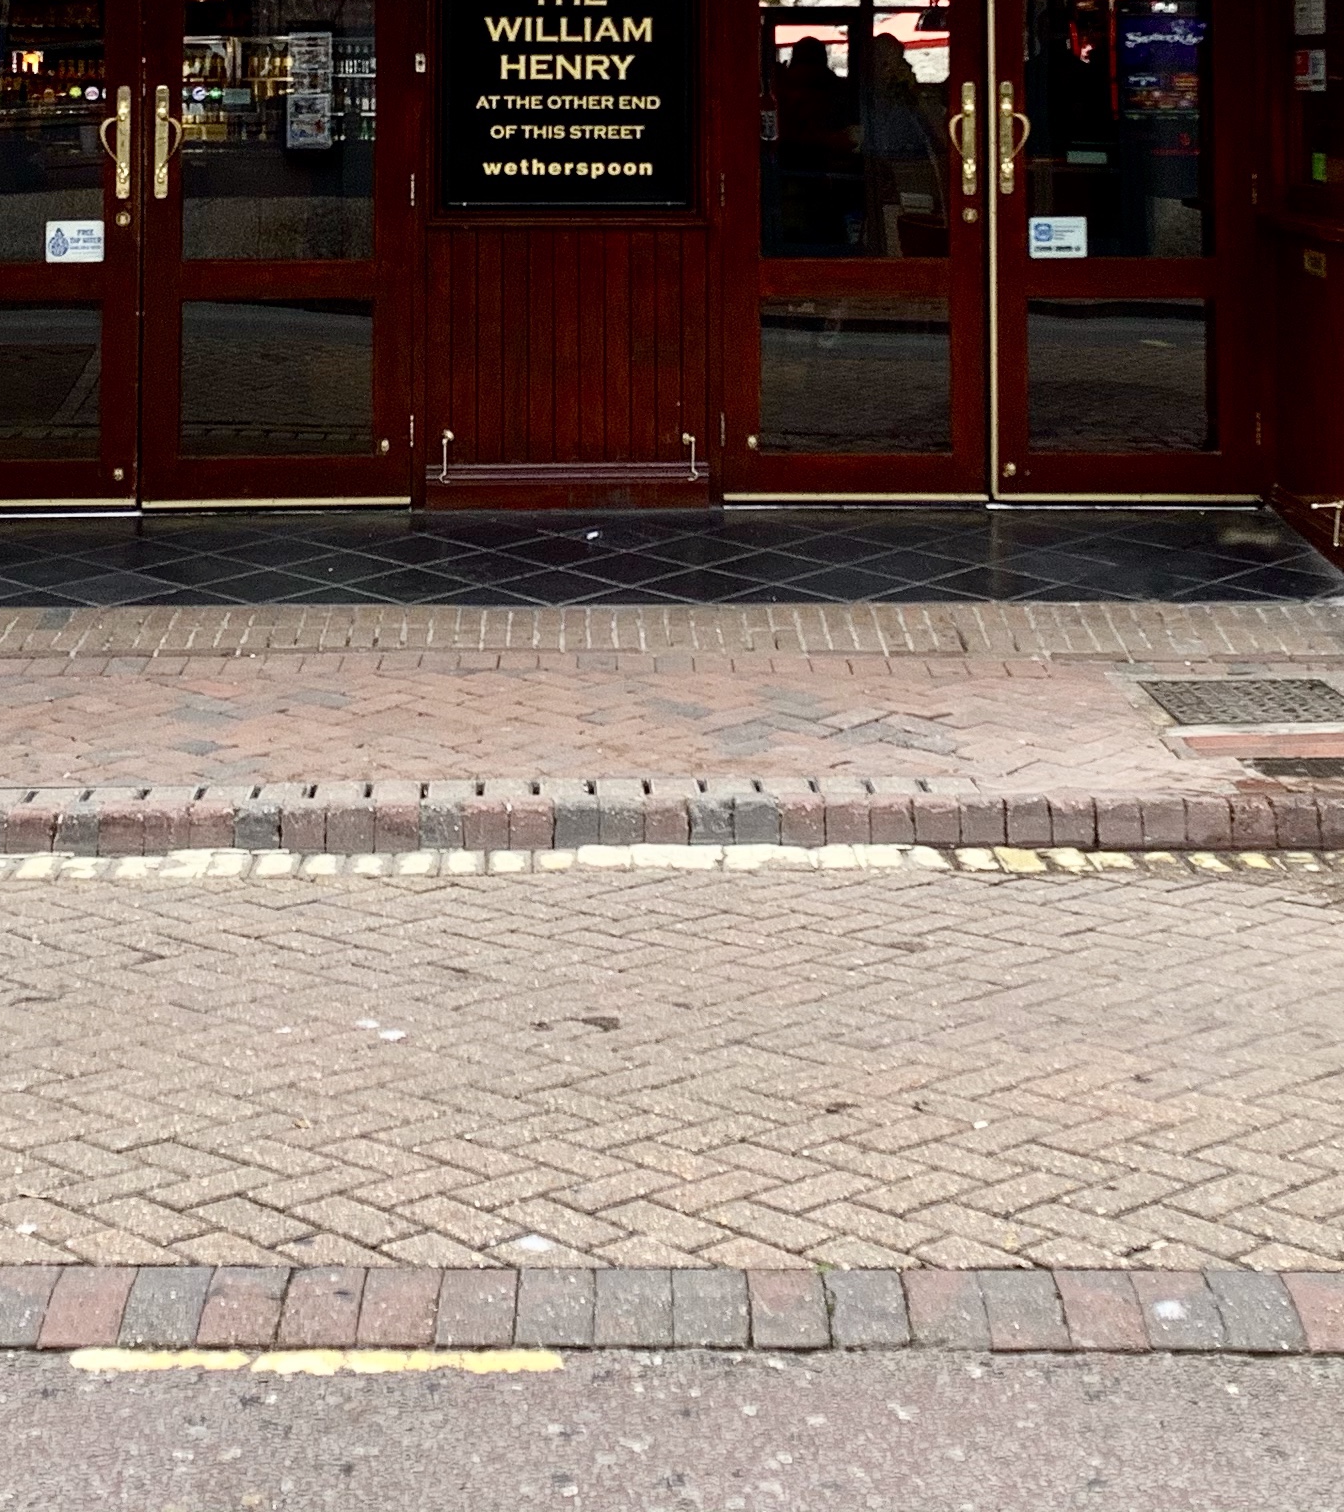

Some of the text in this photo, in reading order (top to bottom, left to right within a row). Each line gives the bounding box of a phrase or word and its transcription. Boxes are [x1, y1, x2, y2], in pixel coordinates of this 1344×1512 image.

[484, 16, 653, 43] WILLIAM
[500, 54, 635, 80] HENRY
[476, 95, 662, 110] AT THE OTHER END
[490, 125, 645, 140] OF THIS STREET
[483, 158, 654, 179] wetherspoon
